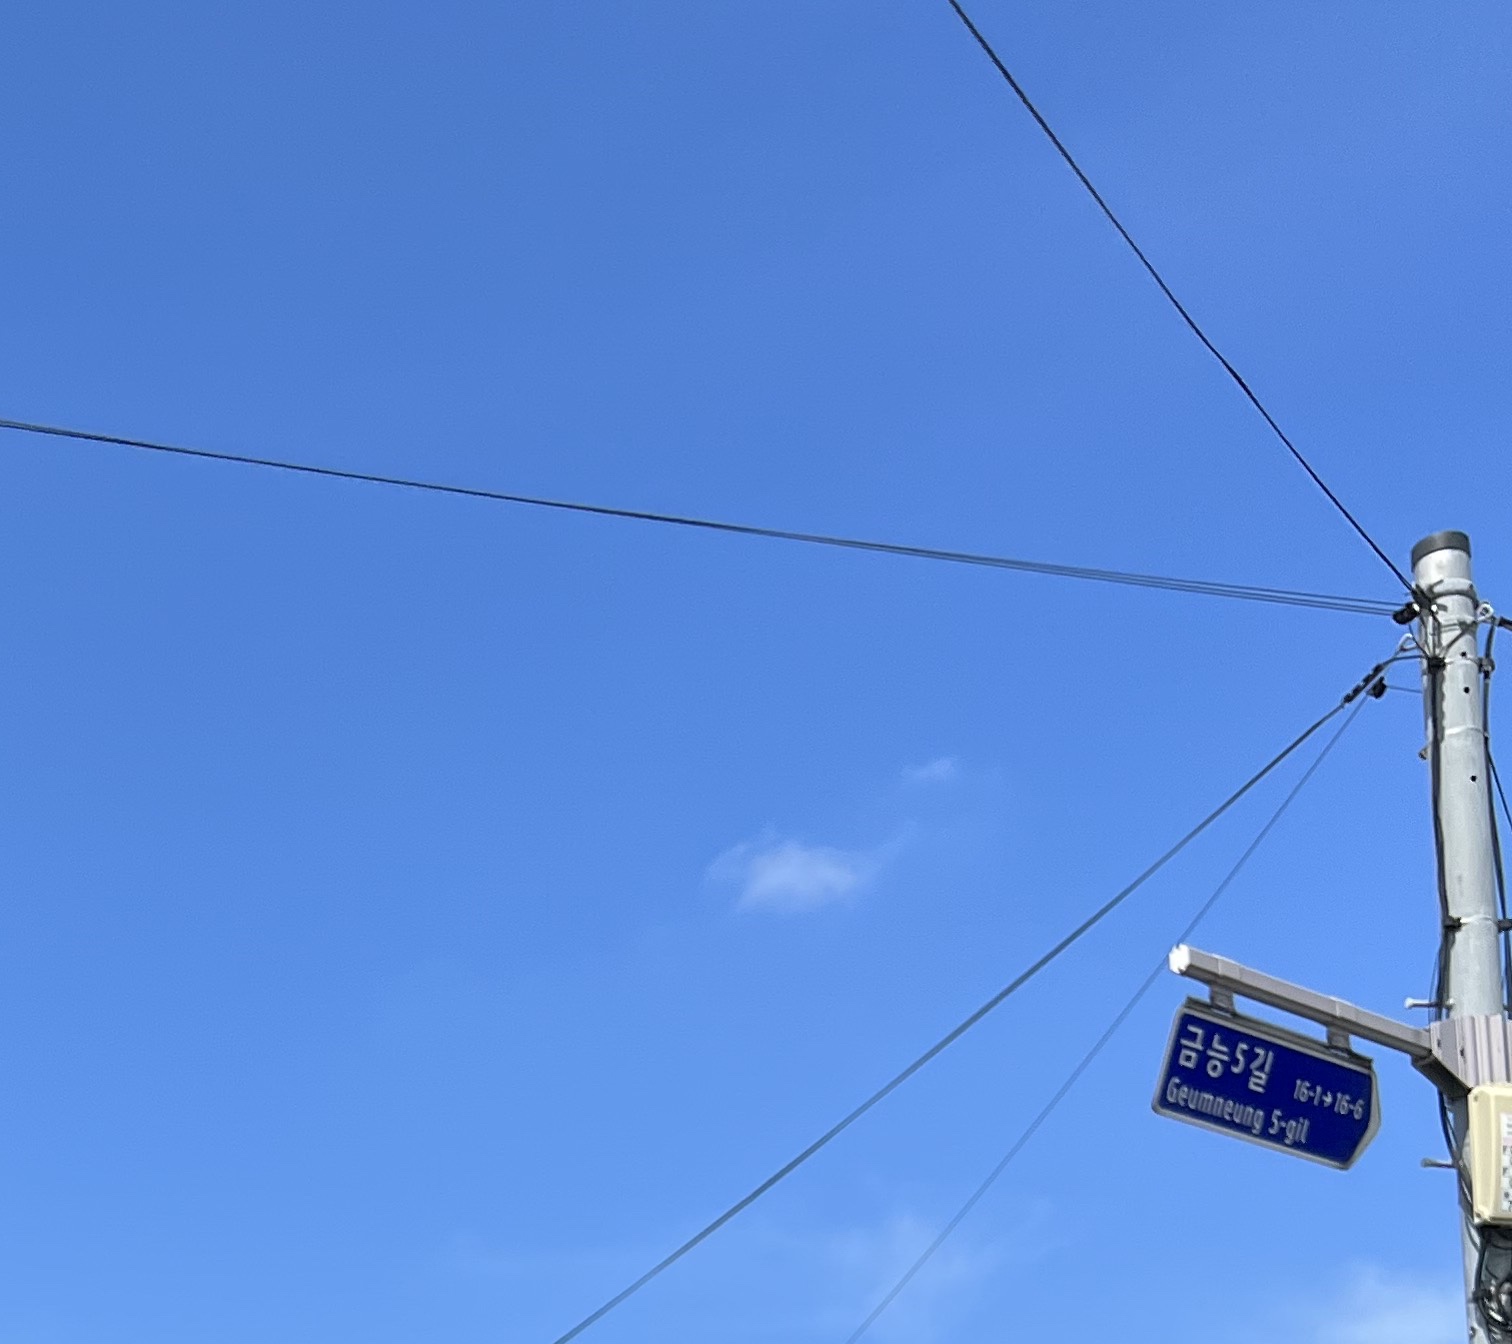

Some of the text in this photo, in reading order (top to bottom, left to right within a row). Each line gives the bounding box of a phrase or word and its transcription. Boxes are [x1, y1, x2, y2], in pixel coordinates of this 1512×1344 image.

[1178, 1024, 1274, 1094] 금능5길
[1166, 1076, 1310, 1145] Geumneung 5-gil
